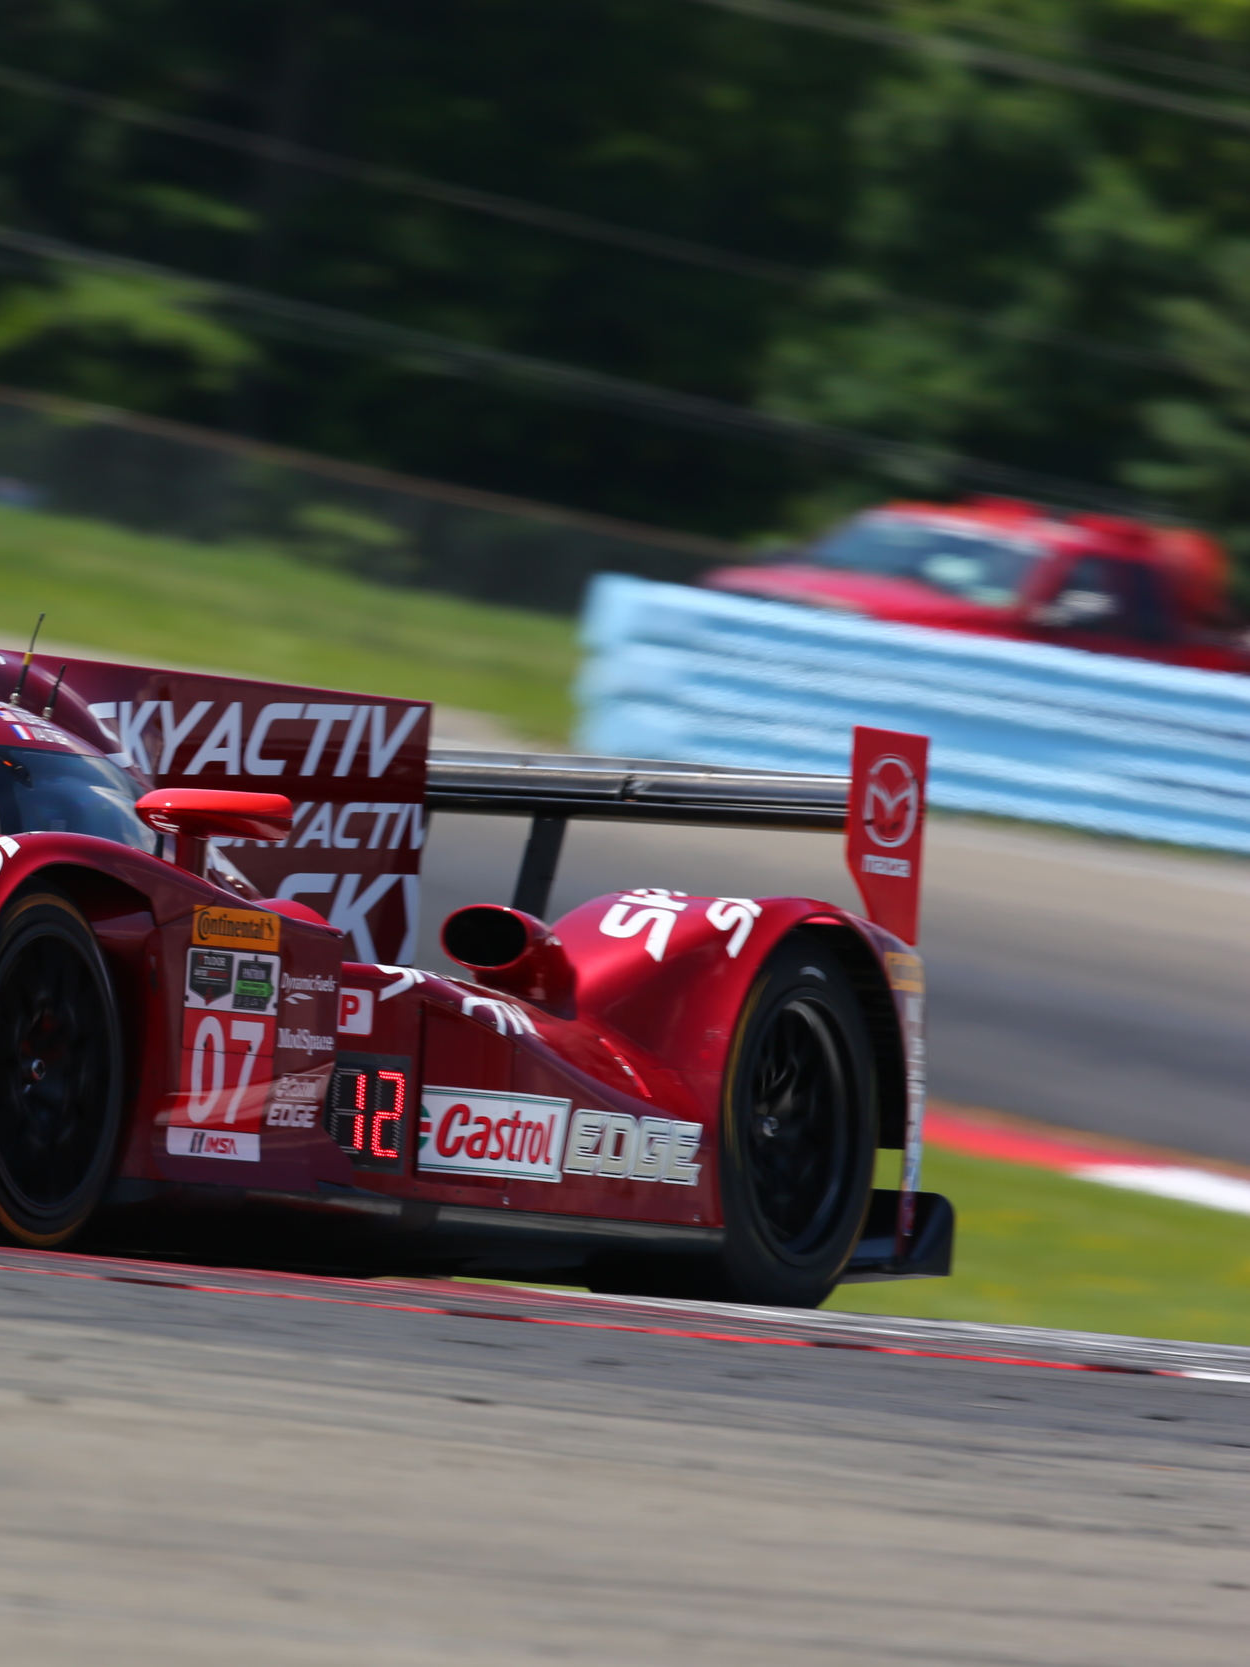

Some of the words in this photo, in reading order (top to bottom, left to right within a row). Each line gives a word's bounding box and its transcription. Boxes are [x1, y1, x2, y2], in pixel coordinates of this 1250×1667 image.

[87, 700, 427, 778] SKYACTIV
[197, 911, 265, 941] Continental
[339, 994, 360, 1027] P
[277, 1027, 336, 1056] ModSpace
[186, 1015, 266, 1125] 07
[266, 1103, 320, 1129] EDGE
[352, 1070, 407, 1159] 12
[204, 1136, 238, 1156] IMSA
[435, 1102, 555, 1166] Castrol
[563, 1108, 703, 1187] EDGE
